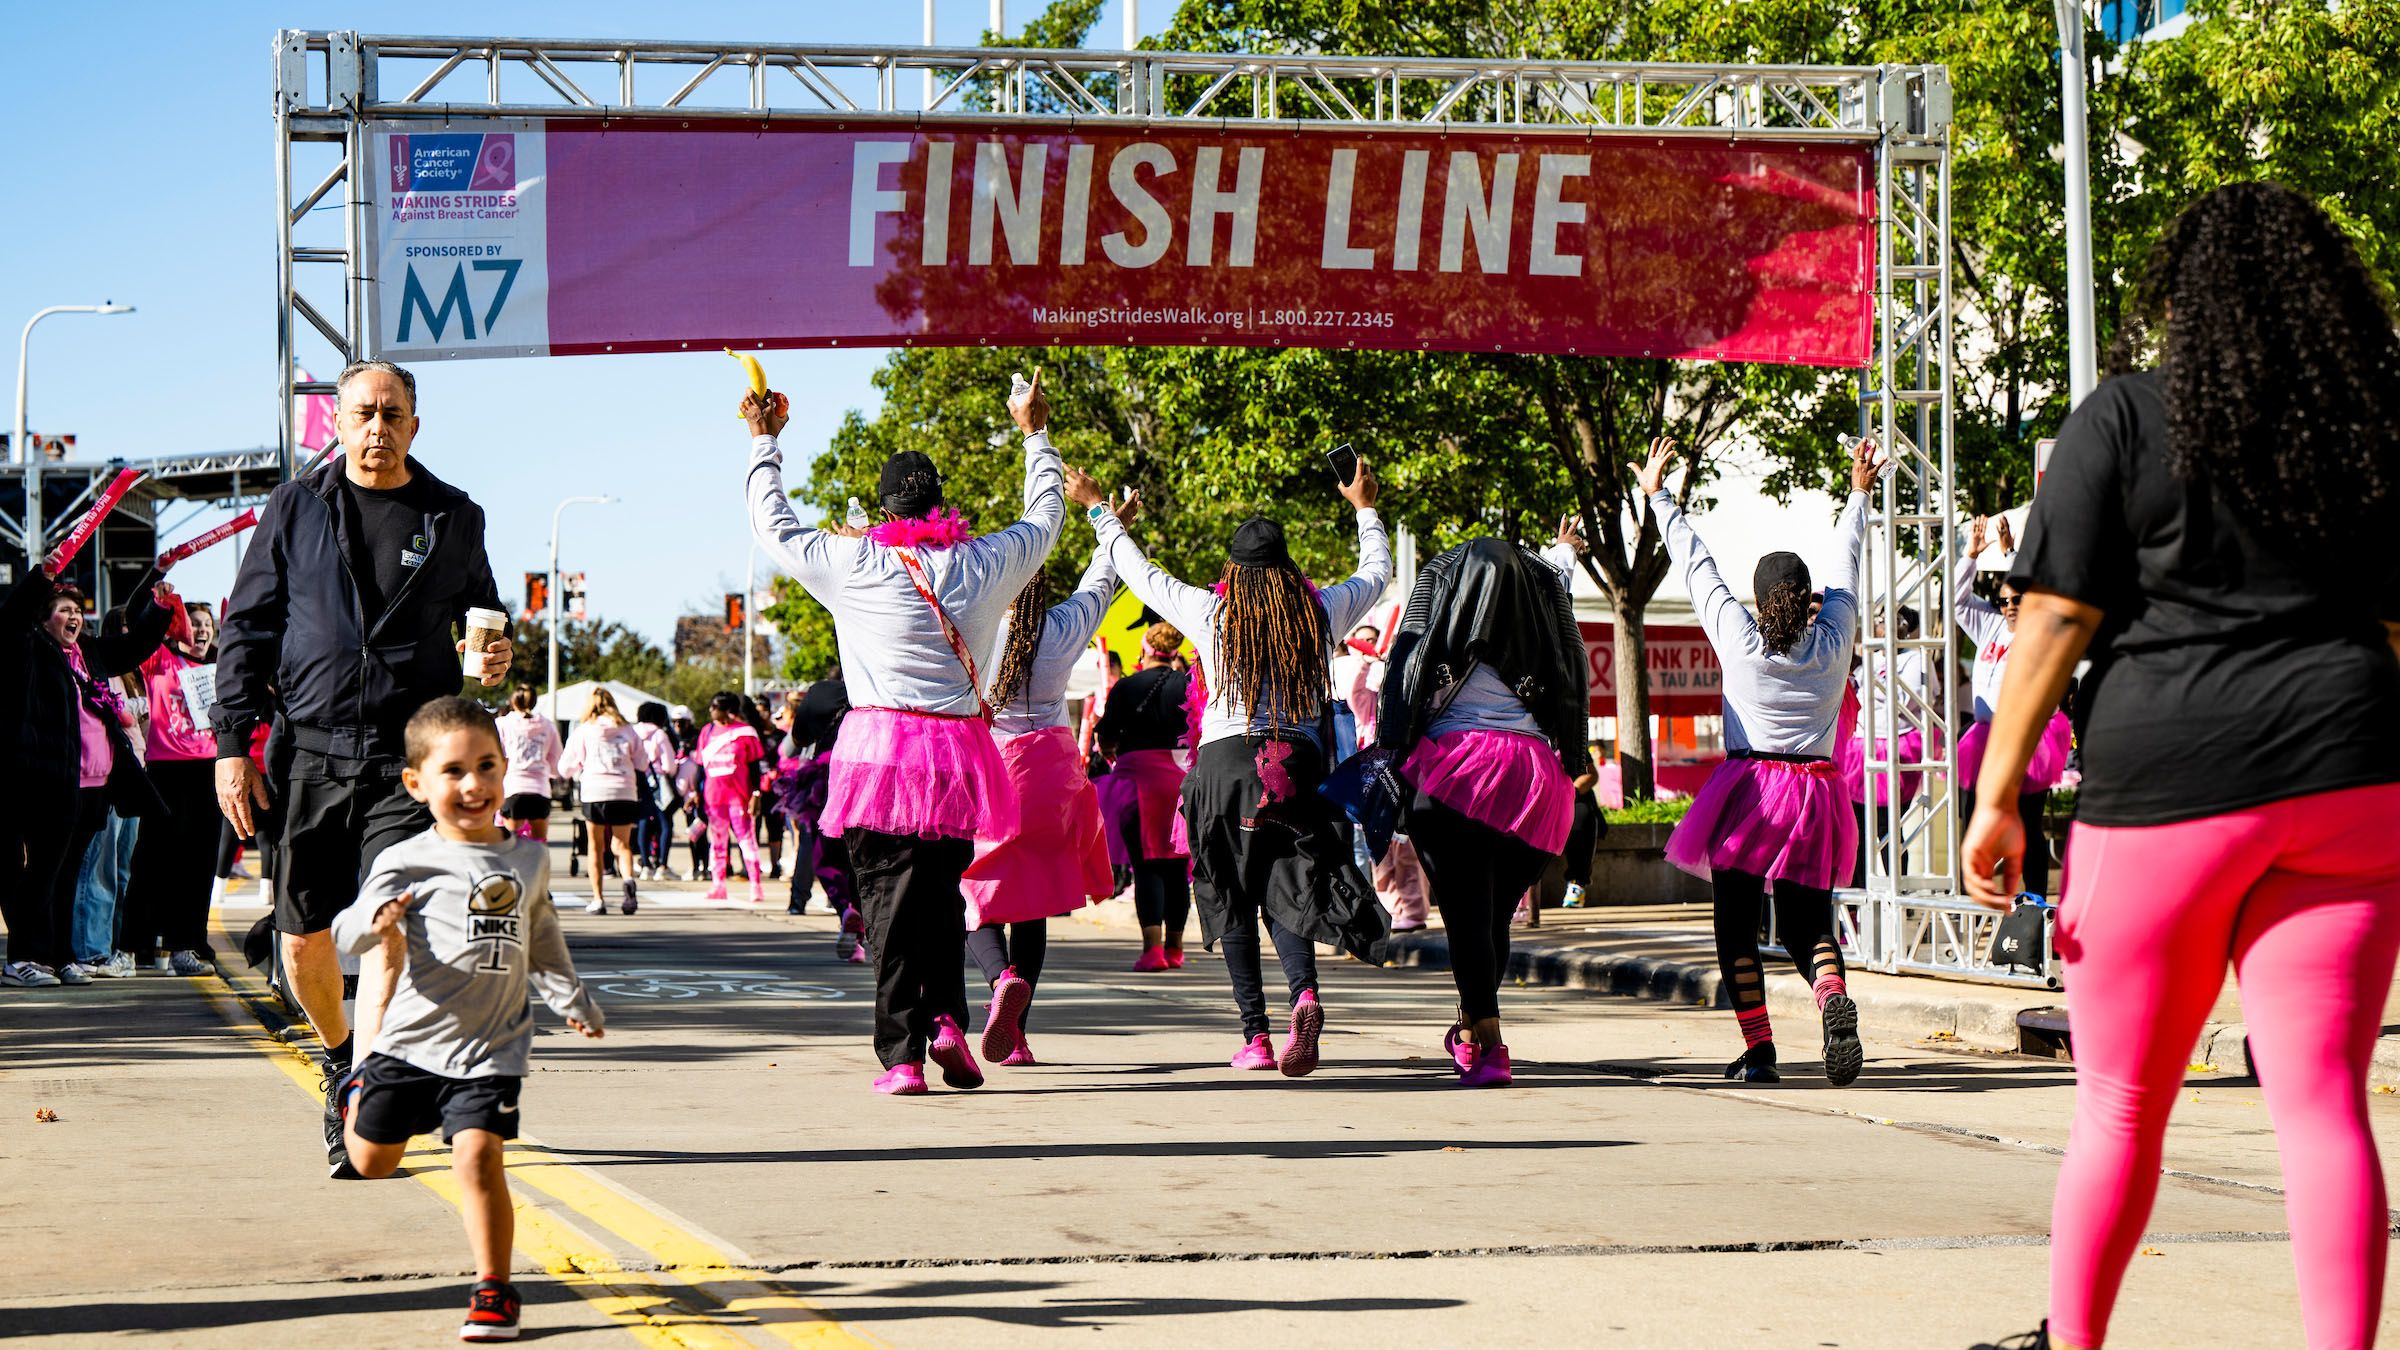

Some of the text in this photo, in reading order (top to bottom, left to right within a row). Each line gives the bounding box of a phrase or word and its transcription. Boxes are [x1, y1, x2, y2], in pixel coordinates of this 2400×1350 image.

[414, 147, 470, 158] American
[414, 158, 455, 168] Cancer
[391, 195, 517, 209] MAKING STRIDES
[848, 141, 1592, 277] FINISH LINE
[392, 209, 435, 223] Against
[437, 209, 474, 220] Breast
[405, 245, 502, 258] SPONSORED BY
[396, 259, 523, 344] M7
[1031, 306, 1244, 328] MakingStridesWalk.org
[1258, 309, 1395, 328] 1.800.227.2345
[1645, 648, 1683, 669] INK
[1660, 672, 1688, 688] TAU
[1692, 672, 1720, 687] ALP
[473, 918, 519, 937] NIKE
